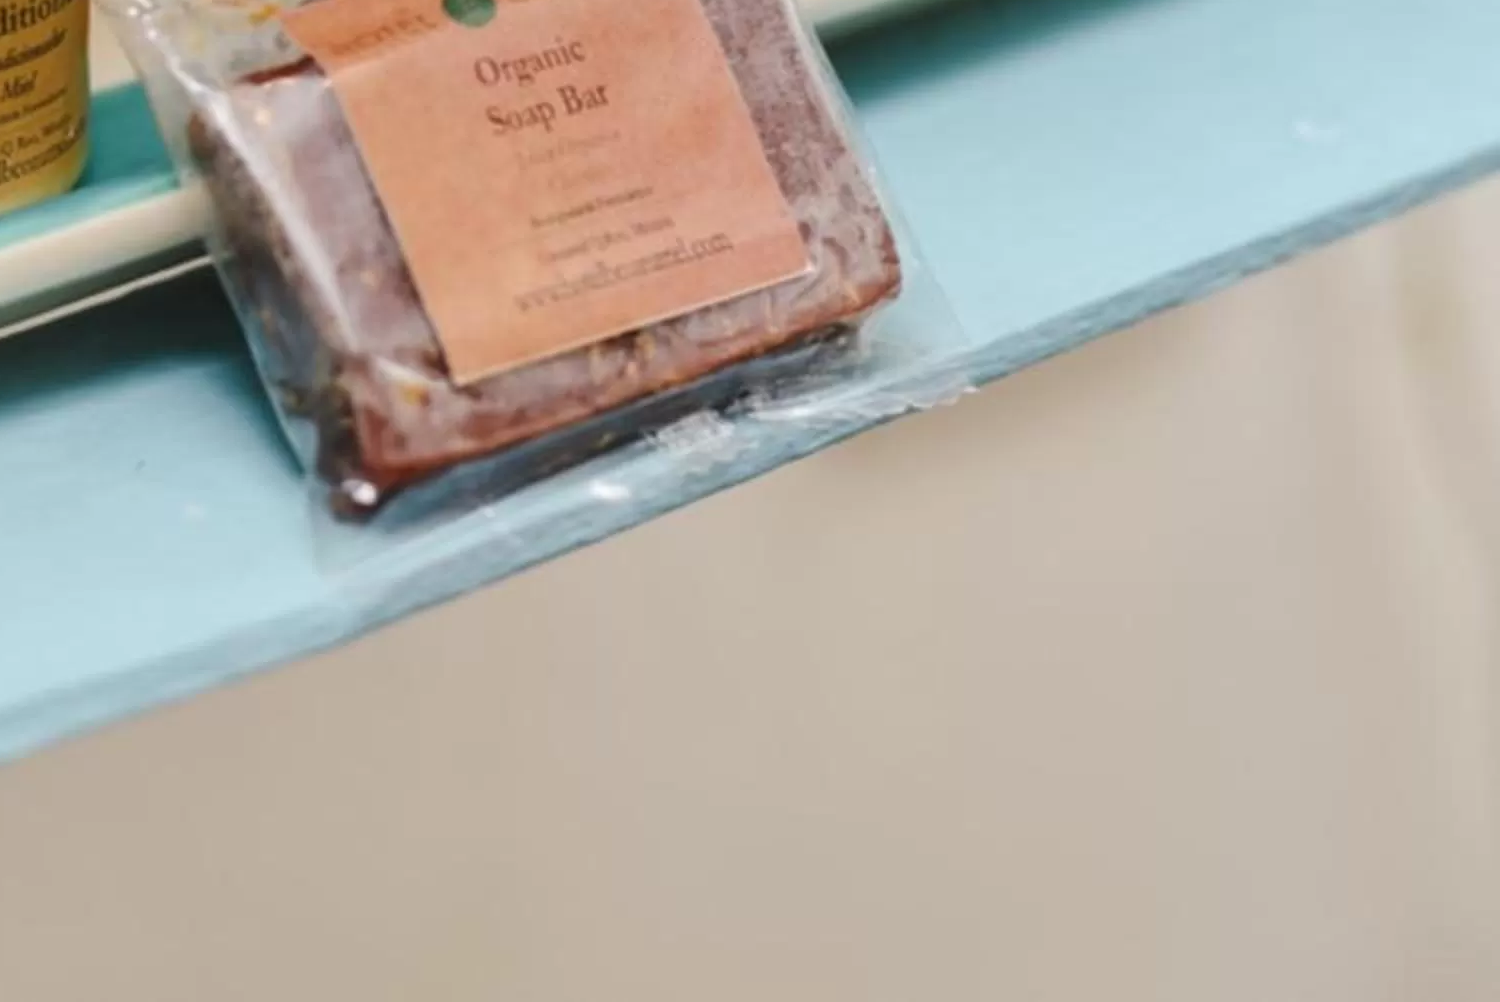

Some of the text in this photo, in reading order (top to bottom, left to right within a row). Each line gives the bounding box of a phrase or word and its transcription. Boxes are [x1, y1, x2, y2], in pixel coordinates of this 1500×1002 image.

[473, 36, 587, 90] Organic
[485, 81, 610, 137] Soap Bar
